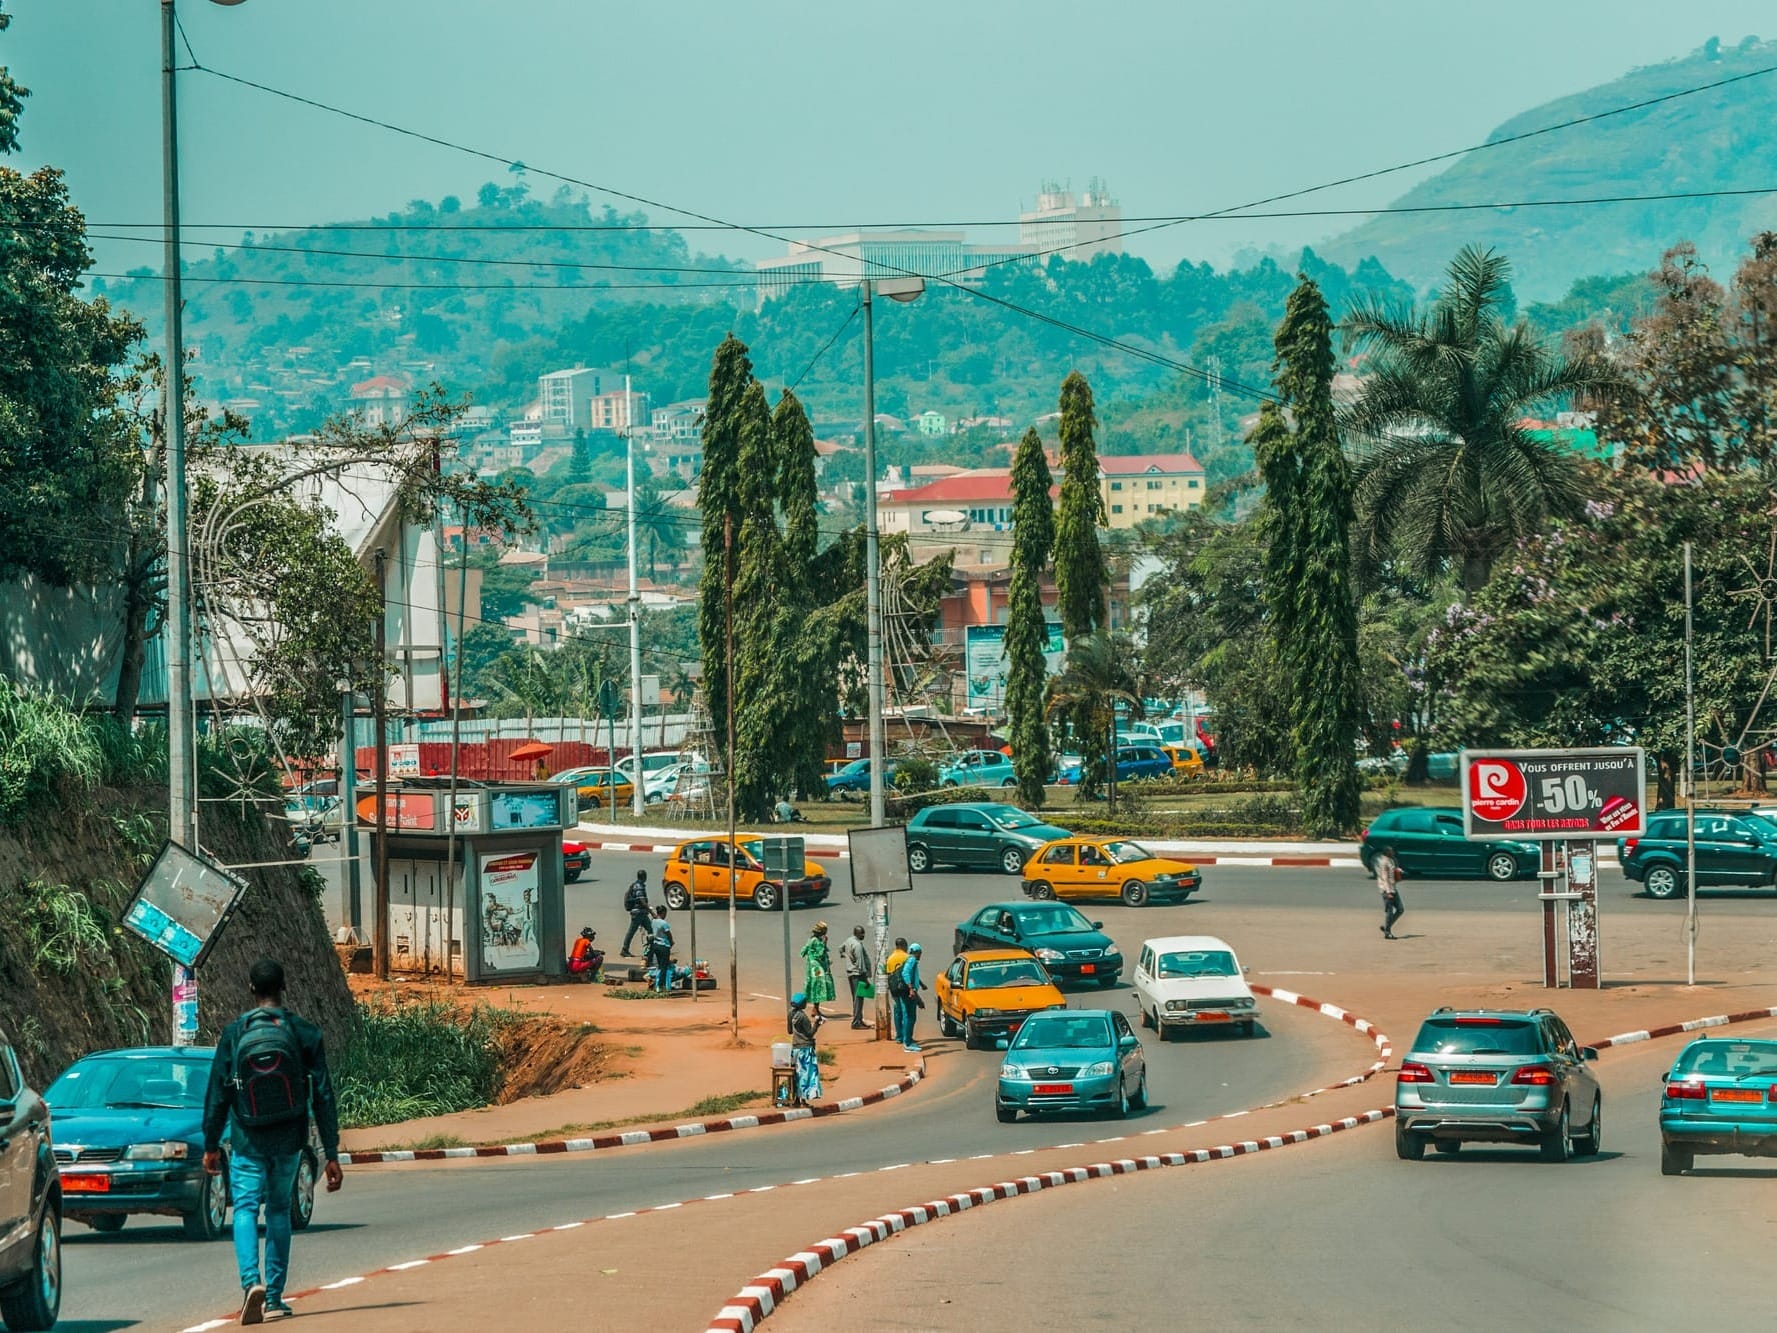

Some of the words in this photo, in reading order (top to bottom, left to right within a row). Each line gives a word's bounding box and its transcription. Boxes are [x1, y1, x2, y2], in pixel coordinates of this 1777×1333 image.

[1551, 762, 1591, 771] OFFRENT
[1471, 799, 1495, 807] pierre
[1495, 798, 1520, 806] cardin
